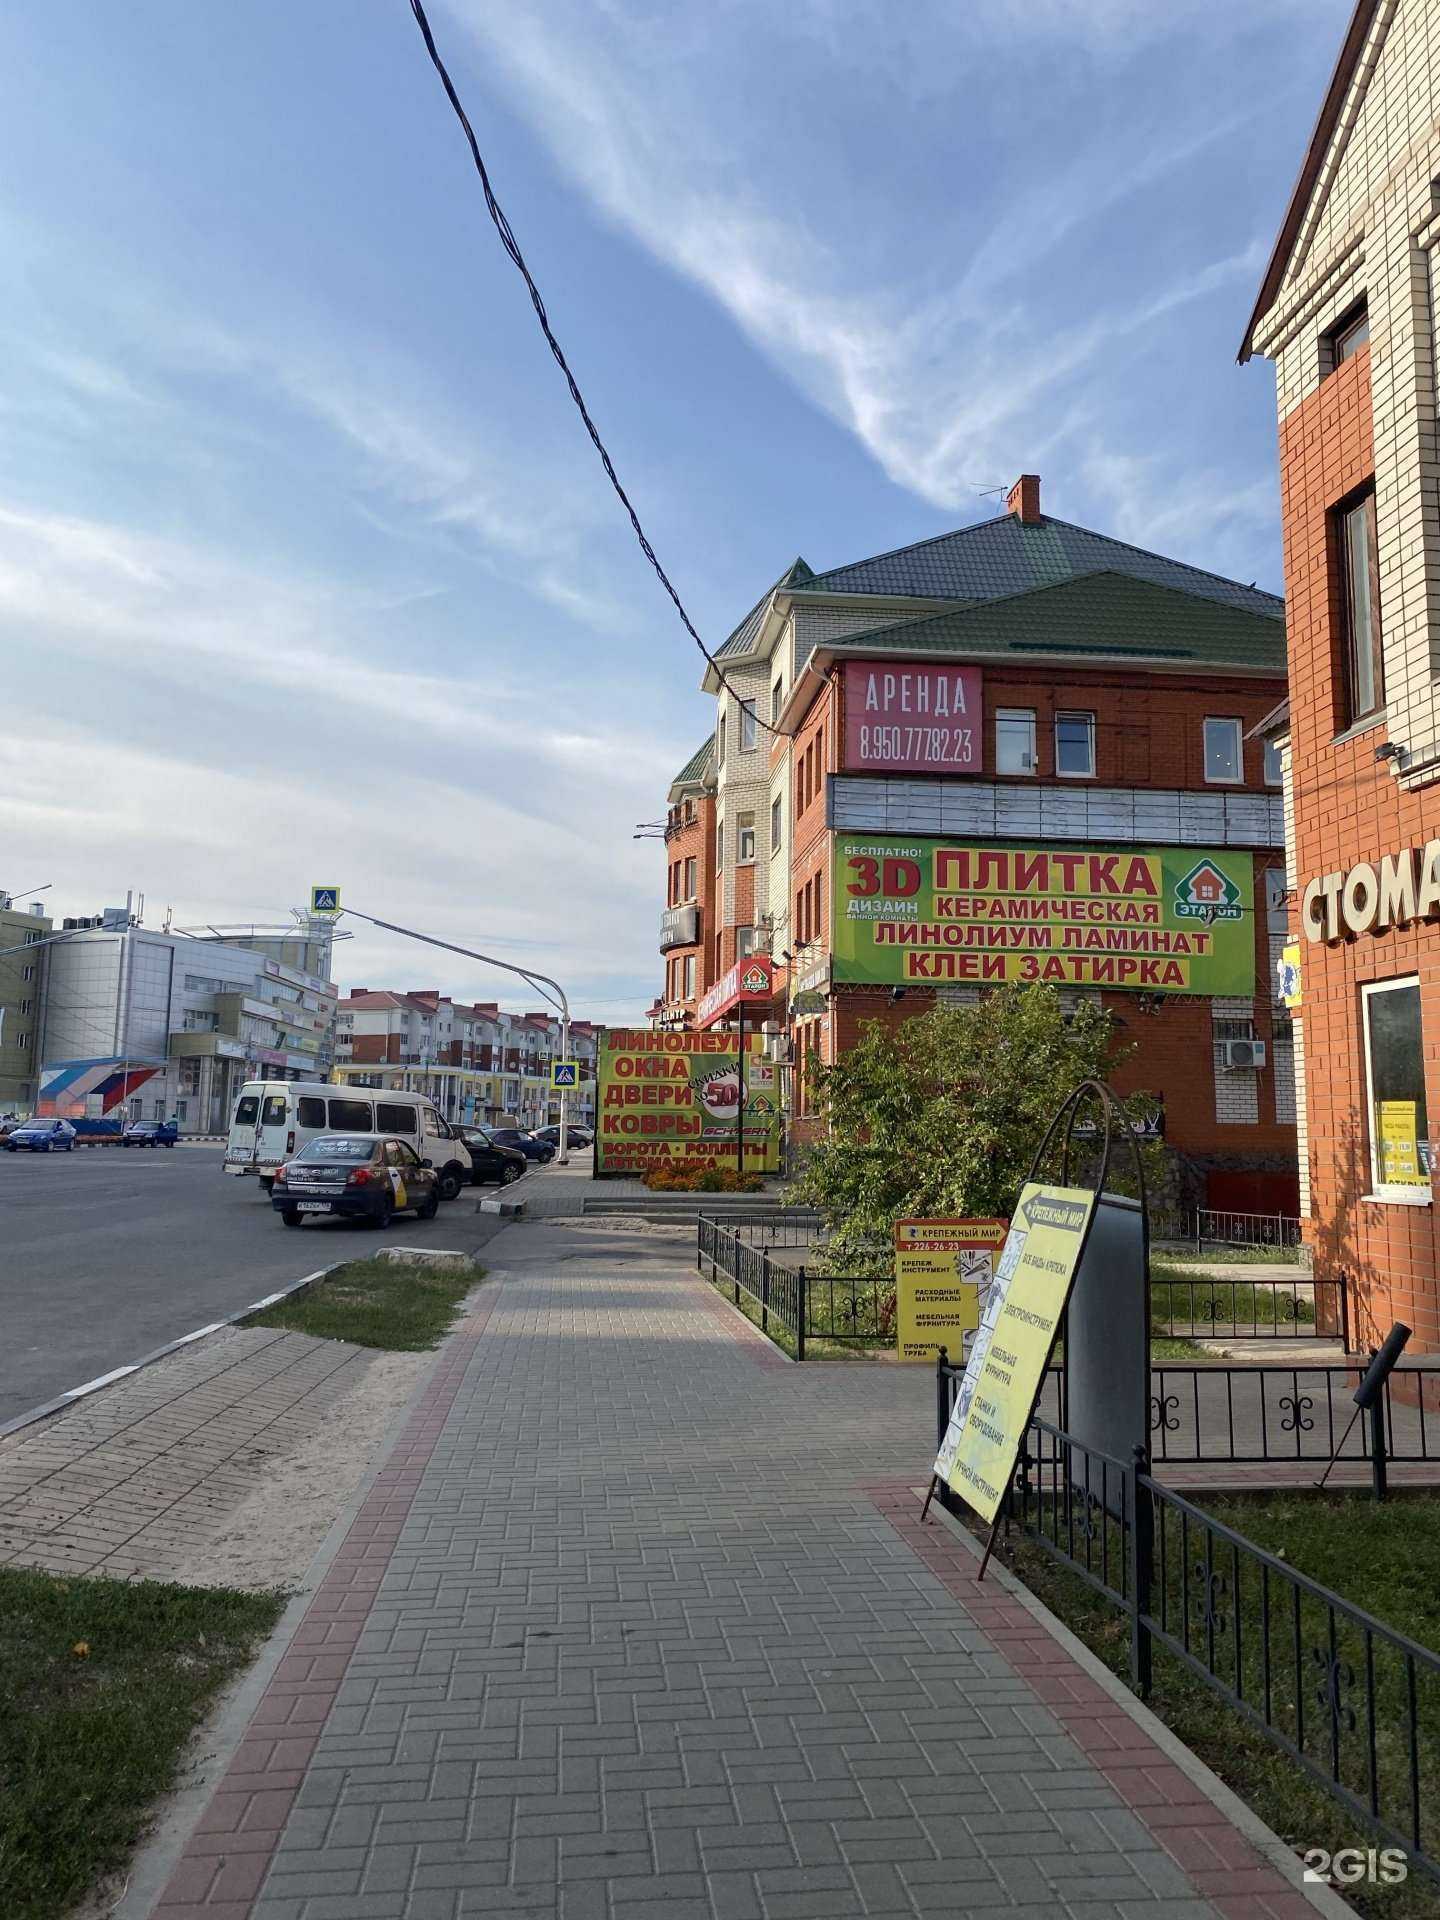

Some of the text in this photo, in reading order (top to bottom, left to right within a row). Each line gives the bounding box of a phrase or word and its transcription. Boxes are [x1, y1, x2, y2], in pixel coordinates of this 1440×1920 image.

[865, 672, 966, 717] АРЕНДА
[844, 846, 922, 858] БЕСПЛАТНО!
[846, 856, 921, 898] 3D
[936, 851, 1158, 896] ПЛИТКА
[847, 898, 918, 915] ДИЗАЙН
[937, 897, 1159, 924] КЕРАМИЧЕСКАЯ
[1180, 903, 1237, 918] ЭТАОН
[880, 914, 918, 923] КОМНАТЫ
[875, 922, 1210, 954] ЛИНОЛИУМ ЛАМИНАТ
[909, 952, 1185, 986] КЛЕИ ЗАТИРКА
[607, 1031, 752, 1053] ЛИНОЛЕУМ
[615, 1056, 689, 1079] ОКНА
[687, 1062, 741, 1090] СКИДКИ
[604, 1084, 692, 1109] ДВЕРИ
[603, 1114, 700, 1135] КОВРЫ
[602, 1142, 672, 1156] ВОРОТА
[604, 1156, 718, 1170] АВТОМАТИКА
[922, 1228, 1001, 1238] КРЕПЕЖНЫЙ МИР
[903, 1342, 941, 1350] ПРОФИЛЬ
